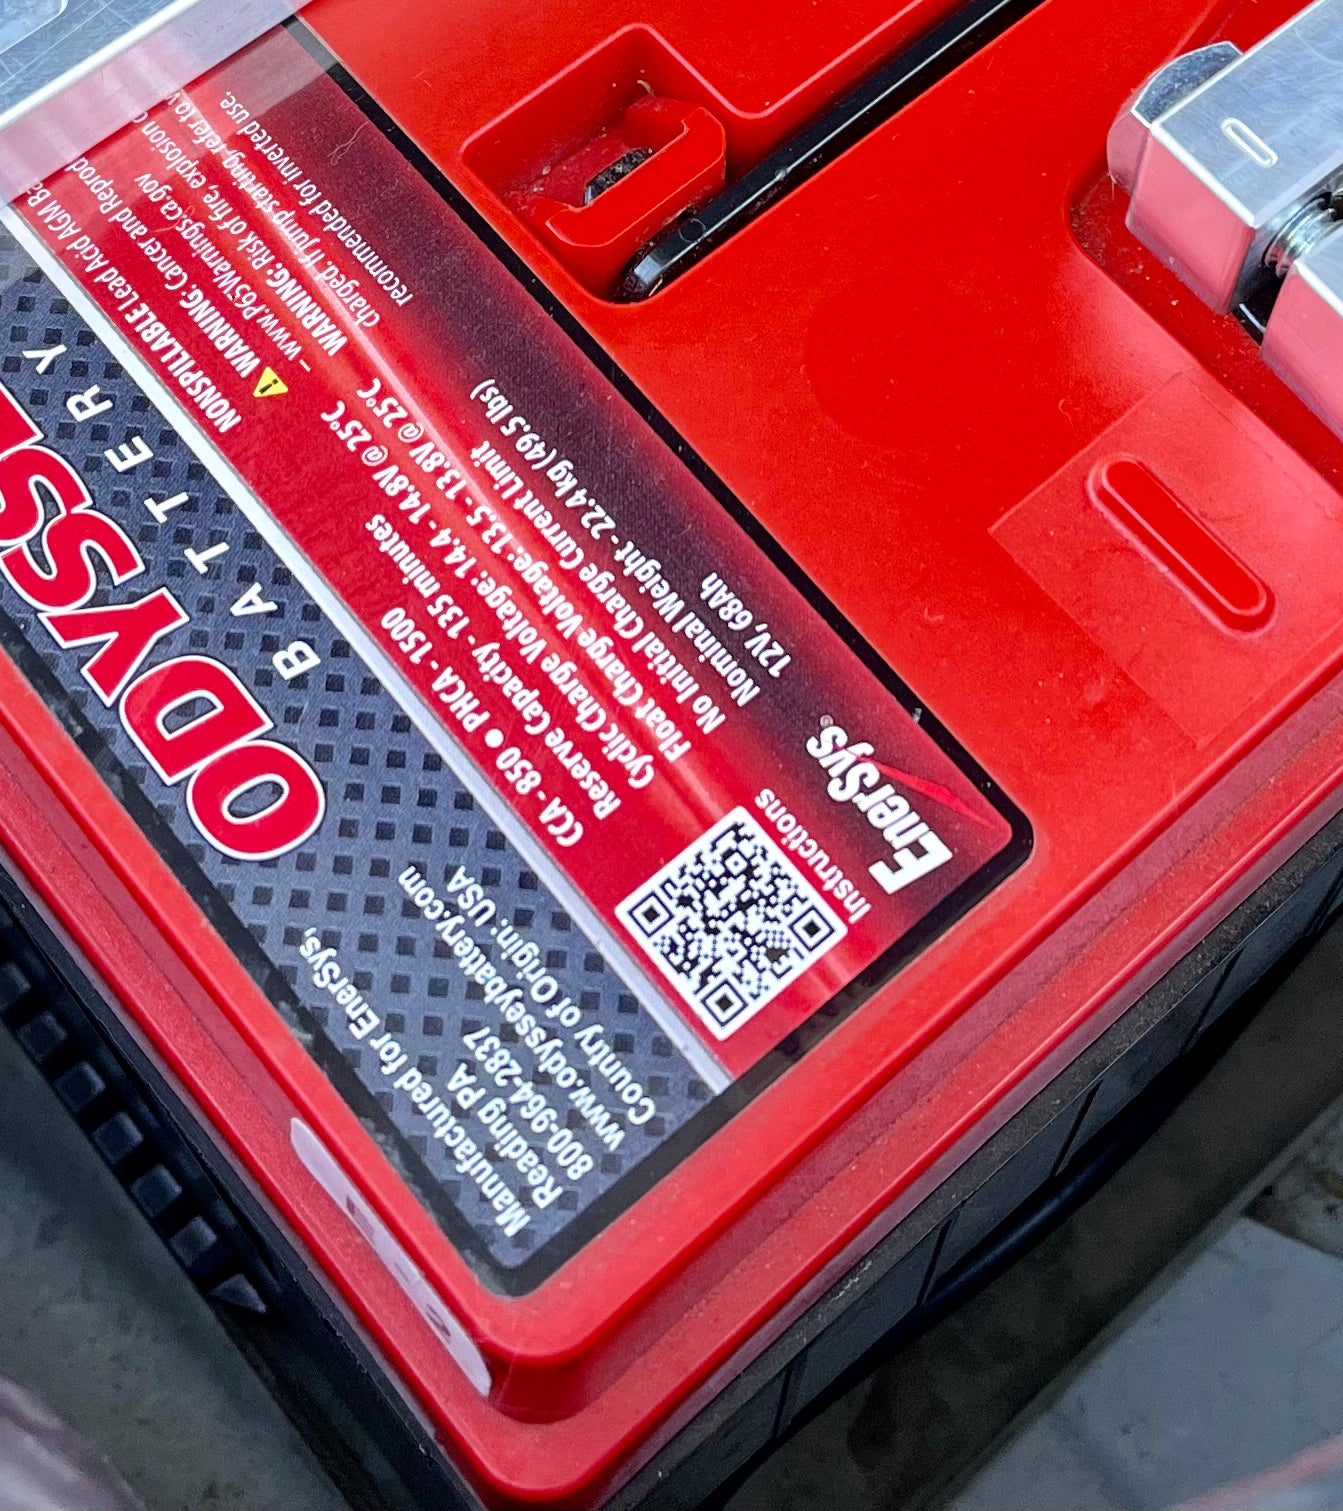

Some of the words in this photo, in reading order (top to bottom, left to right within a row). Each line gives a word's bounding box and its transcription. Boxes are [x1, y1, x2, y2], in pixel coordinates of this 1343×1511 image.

[170, 99, 198, 122] to
[184, 116, 228, 157] refer
[218, 90, 250, 125] use.
[139, 119, 206, 189] explosion
[214, 146, 286, 216] starting,
[235, 119, 303, 185] inverted
[35, 198, 82, 240] AGM
[106, 205, 148, 240] and
[201, 183, 233, 222] fire,
[291, 177, 322, 207] for
[64, 233, 109, 273] Acid
[215, 214, 248, 236] of
[235, 229, 275, 271] Risk
[266, 203, 321, 254] jump
[297, 244, 326, 268] If
[307, 199, 413, 306] recommended
[92, 265, 140, 312] Lead
[133, 172, 302, 360] www.P65Warnings.ca.gov
[136, 236, 189, 291] Cancer
[310, 256, 388, 332] charged.
[178, 283, 260, 378] WARNING:
[265, 262, 347, 356] WARNING:
[124, 302, 241, 432] NONSPILLABLE
[468, 377, 513, 424] lbs)
[407, 437, 472, 501] 13.8V
[469, 439, 524, 500] Limit
[499, 415, 557, 470] (49.5
[371, 463, 431, 524] 14.8V
[545, 458, 578, 498] kg
[22, 344, 320, 679] BATTERY
[463, 502, 517, 555] 13.5
[512, 489, 585, 570] Current
[563, 487, 616, 540] 22.4
[364, 513, 441, 598] minutes
[428, 526, 477, 579] 14.4
[613, 540, 685, 623] Weight
[425, 593, 470, 639] 135
[470, 569, 547, 663] Voltage:
[498, 540, 595, 639] Voltage:
[577, 562, 644, 639] Charge
[699, 571, 753, 631] 68Ah
[379, 606, 433, 664] 1500
[568, 621, 654, 708] Charge
[671, 611, 760, 706] Nominal
[743, 622, 791, 678] 12V,
[430, 665, 490, 733] PHCA
[471, 641, 551, 735] Capacity
[540, 651, 607, 732] Charge
[631, 631, 699, 704] Initial
[628, 696, 694, 763] Float
[691, 694, 726, 735] No
[495, 745, 542, 795] 850
[543, 726, 621, 820] Reserve
[597, 721, 655, 789] Cyclic
[538, 795, 584, 847] CCA
[754, 788, 871, 923] Instructions
[440, 864, 500, 927] USA
[285, 923, 388, 1039] EnerSys,
[481, 912, 568, 1005] Origin:
[394, 864, 629, 1152] www.odysseybattery.com
[543, 992, 584, 1033] of
[362, 1028, 410, 1078] for
[440, 1060, 487, 1110] PA
[565, 1017, 666, 1128] Country
[458, 1020, 598, 1182] 800-964-2837
[389, 1065, 535, 1238] Manufactured
[468, 1094, 570, 1209] Reading
